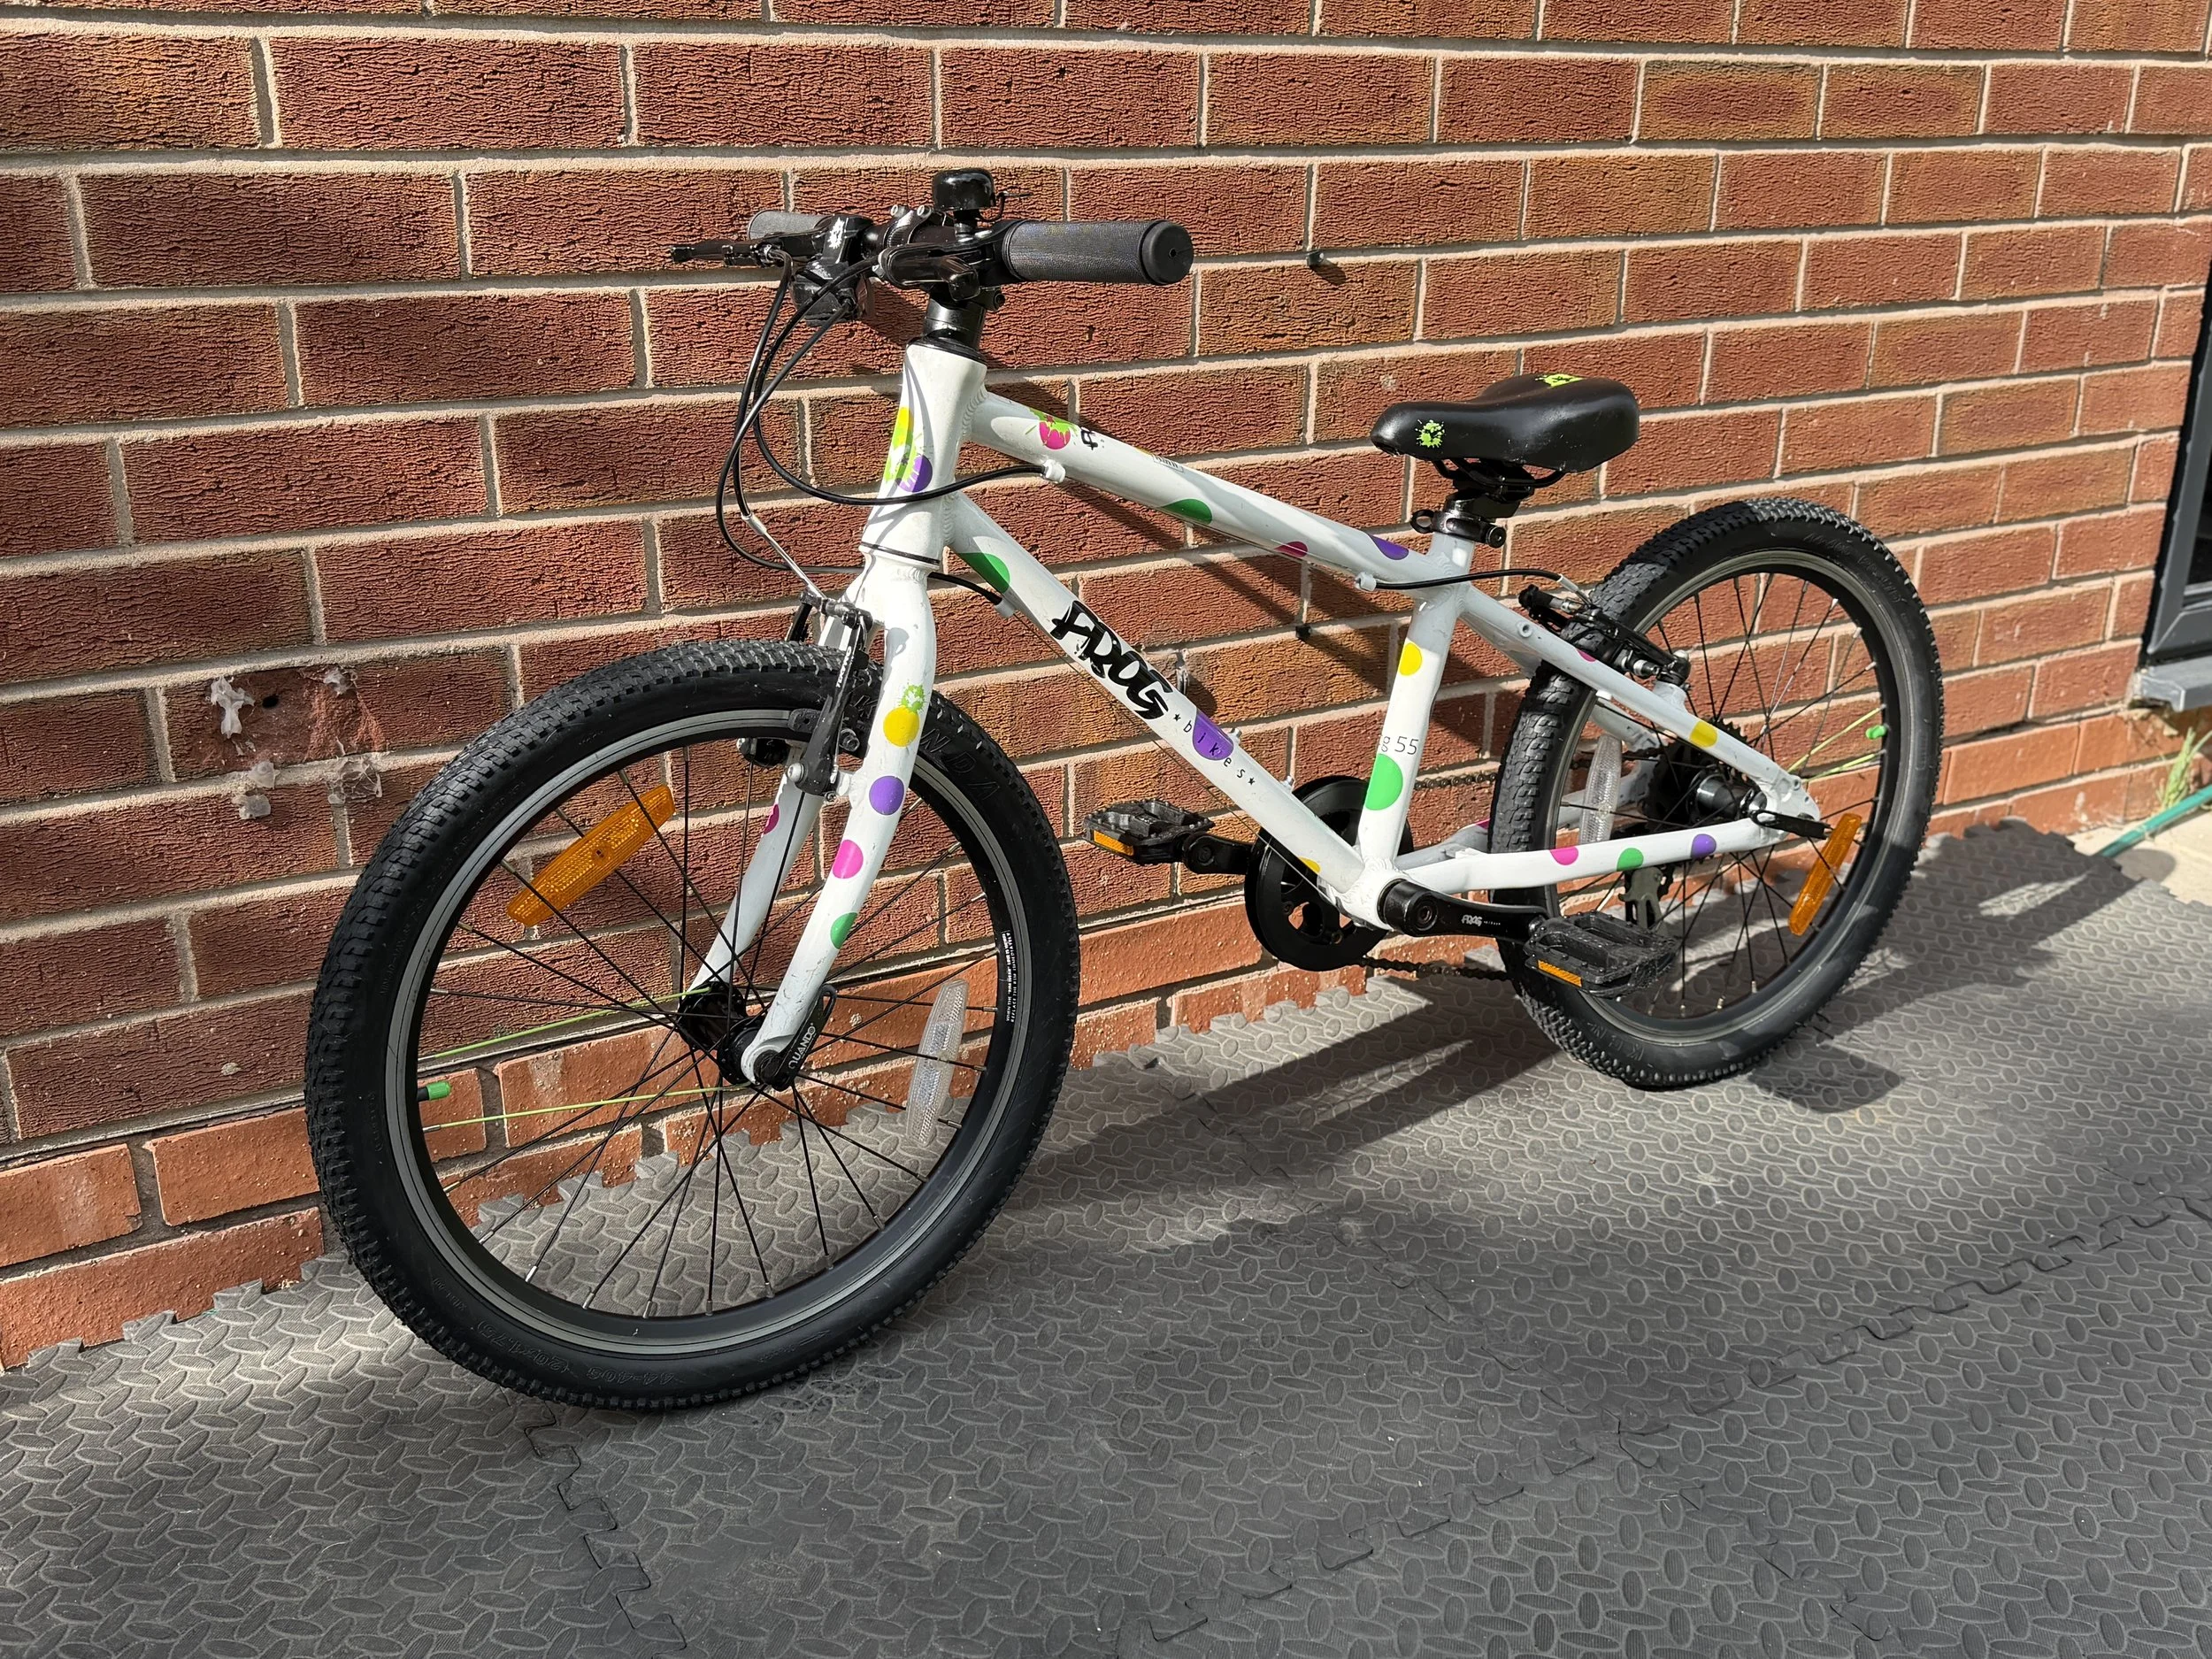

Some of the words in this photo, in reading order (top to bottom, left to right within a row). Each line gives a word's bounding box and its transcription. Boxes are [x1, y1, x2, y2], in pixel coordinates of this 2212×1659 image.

[1050, 600, 1173, 719] FROG
[1394, 735, 1419, 755] 55
[1461, 914, 1483, 927] FROG
[787, 1025, 816, 1070] QUANDO
